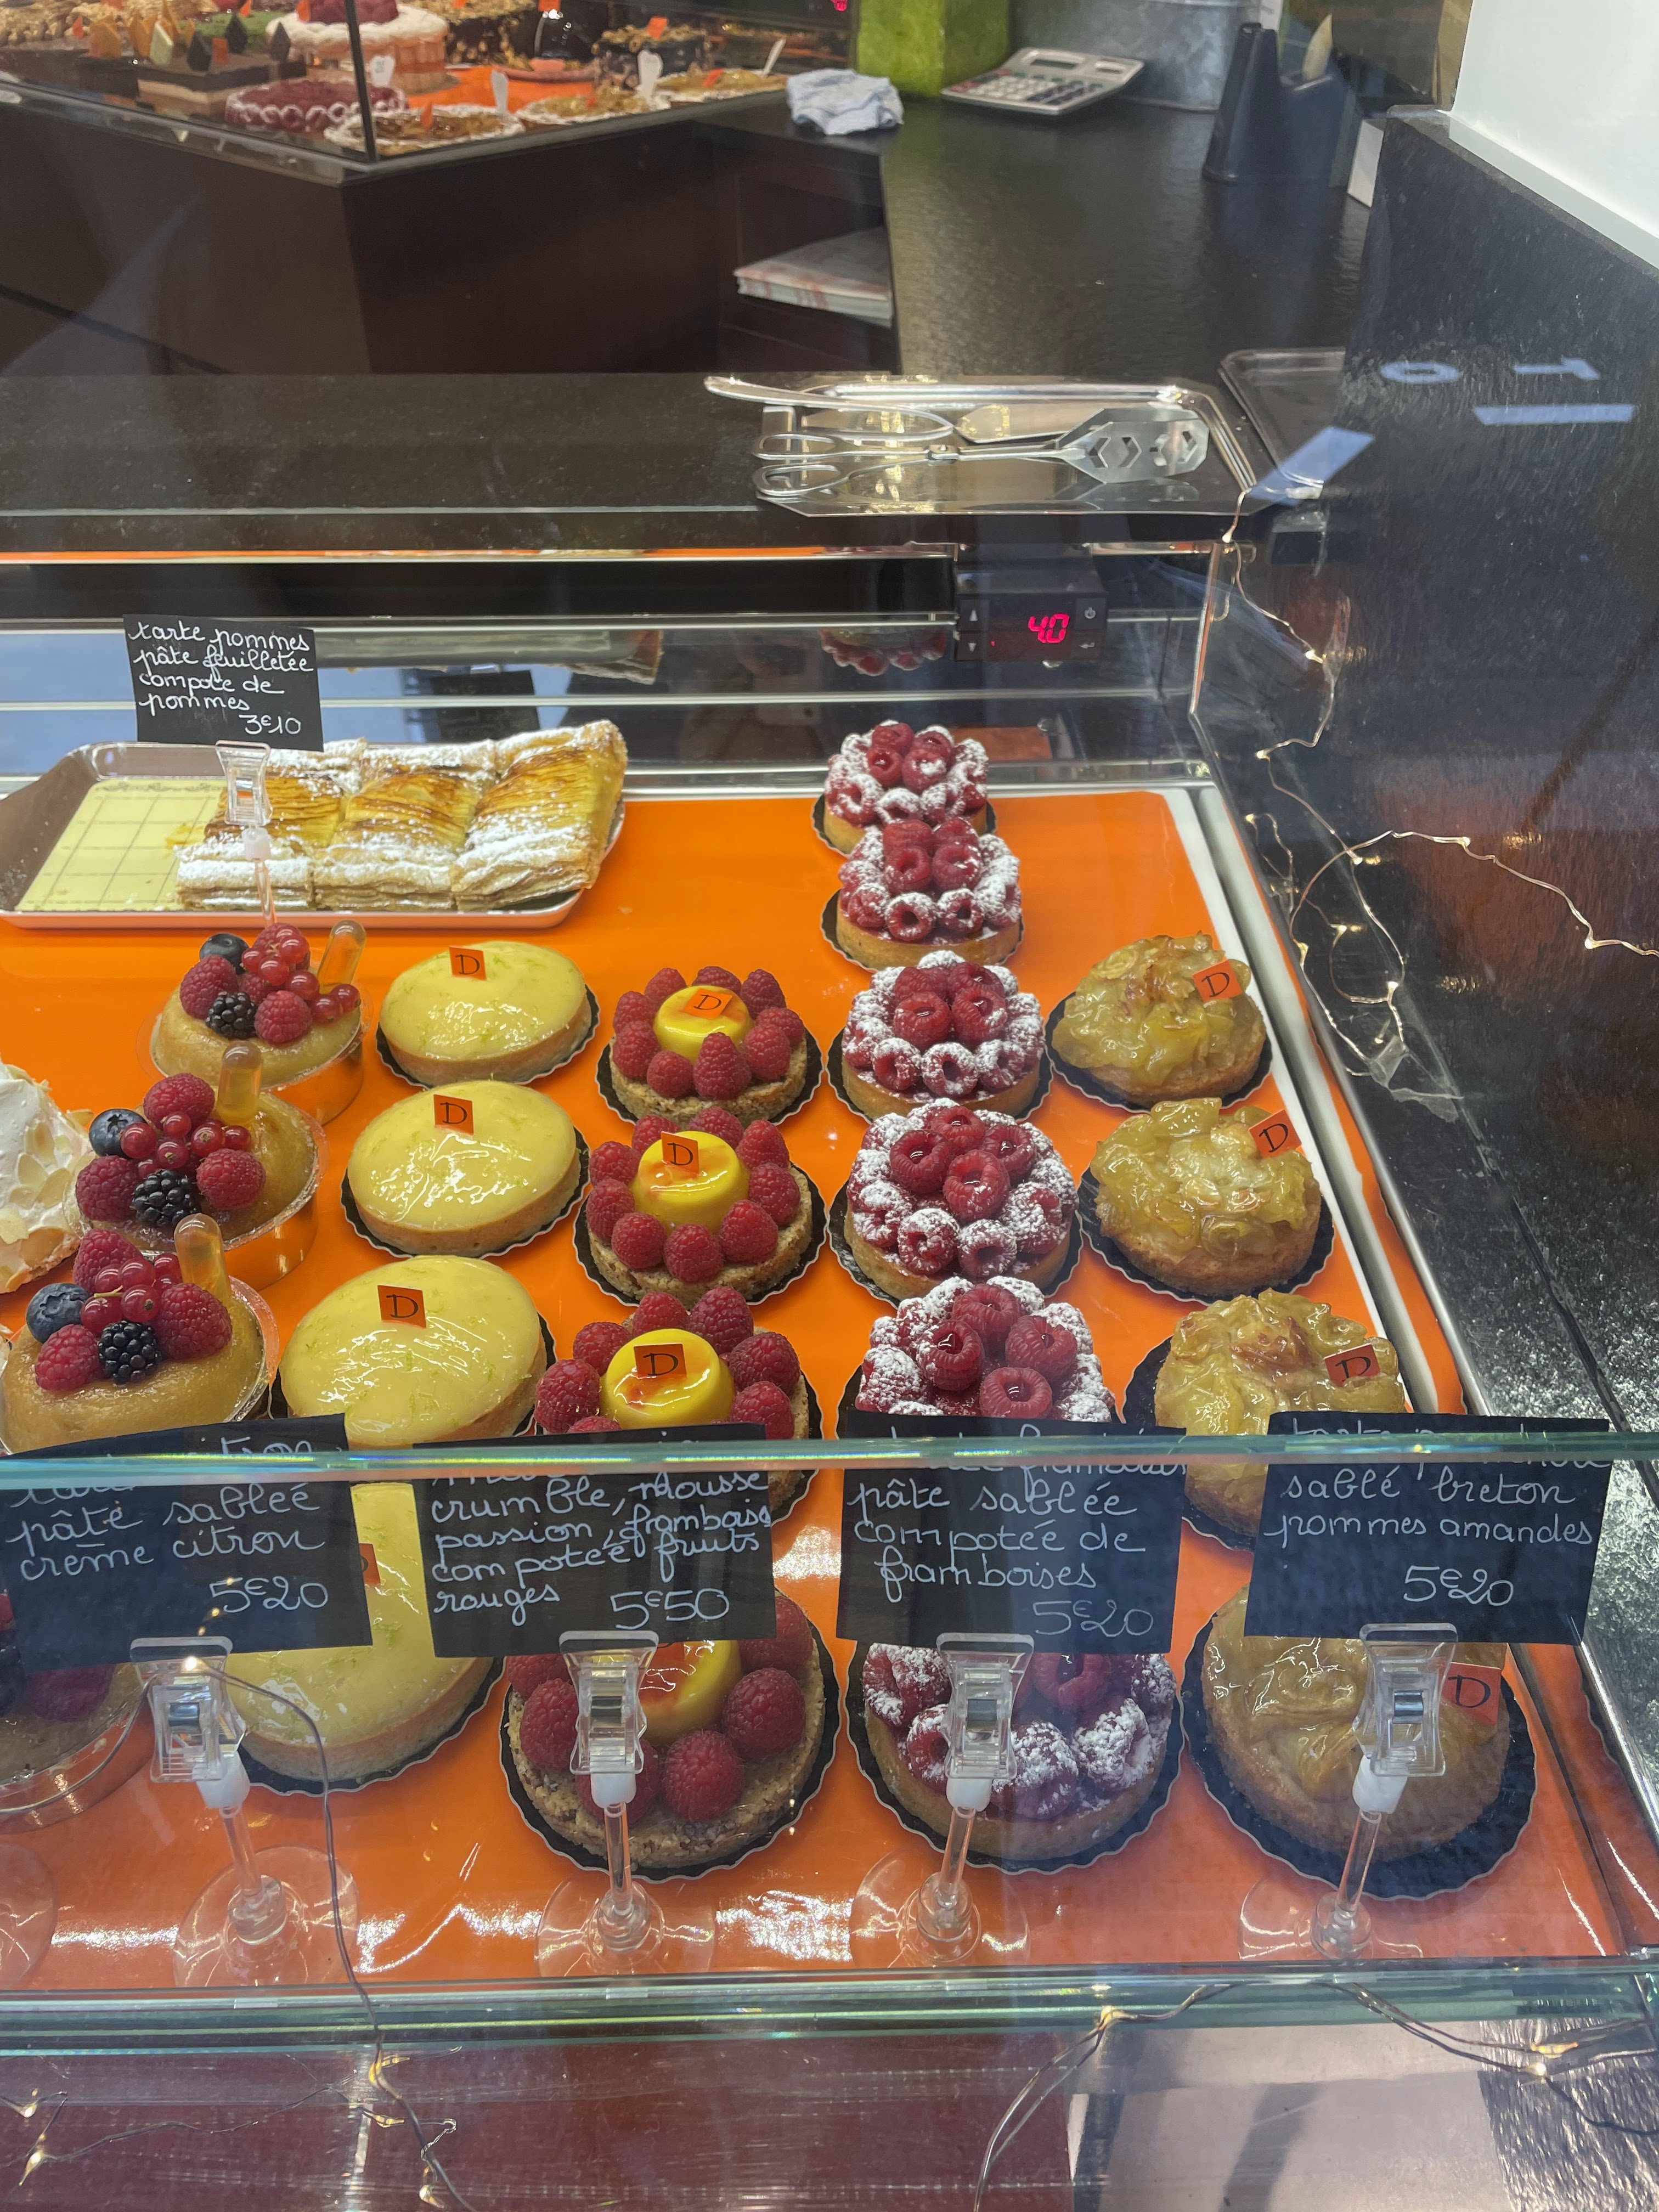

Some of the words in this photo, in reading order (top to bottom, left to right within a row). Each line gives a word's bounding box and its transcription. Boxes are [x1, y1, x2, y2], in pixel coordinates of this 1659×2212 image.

[128, 620, 205, 642] tarte
[209, 628, 310, 656] pommes
[1028, 613, 1070, 644] 40
[133, 646, 199, 676] pâte
[202, 645, 314, 682] feuilletée
[139, 673, 235, 697] compote
[242, 674, 285, 694] de
[138, 692, 250, 716] pommes
[455, 955, 480, 975] D
[1201, 971, 1230, 998] D
[693, 994, 722, 1011] D
[441, 1102, 467, 1125] D
[1259, 1122, 1289, 1153] D
[668, 1142, 693, 1166] D
[386, 1294, 419, 1318] D
[643, 1352, 679, 1376] D
[1335, 1358, 1372, 1381] D
[628, 1471, 769, 1500] mousse
[1280, 1465, 1401, 1500] sablé
[1428, 1465, 1576, 1504] breton
[847, 1478, 951, 1523] pâte
[6, 1506, 143, 1558] pâte
[172, 1525, 325, 1558] citron
[1079, 1522, 1146, 1552] de
[1263, 1514, 1426, 1549] pommes
[1440, 1513, 1592, 1545] amandes
[654, 1528, 760, 1583] fruits
[874, 1545, 1097, 1603] framboises
[433, 1584, 561, 1627] rouges
[1448, 1674, 1491, 1708] D
